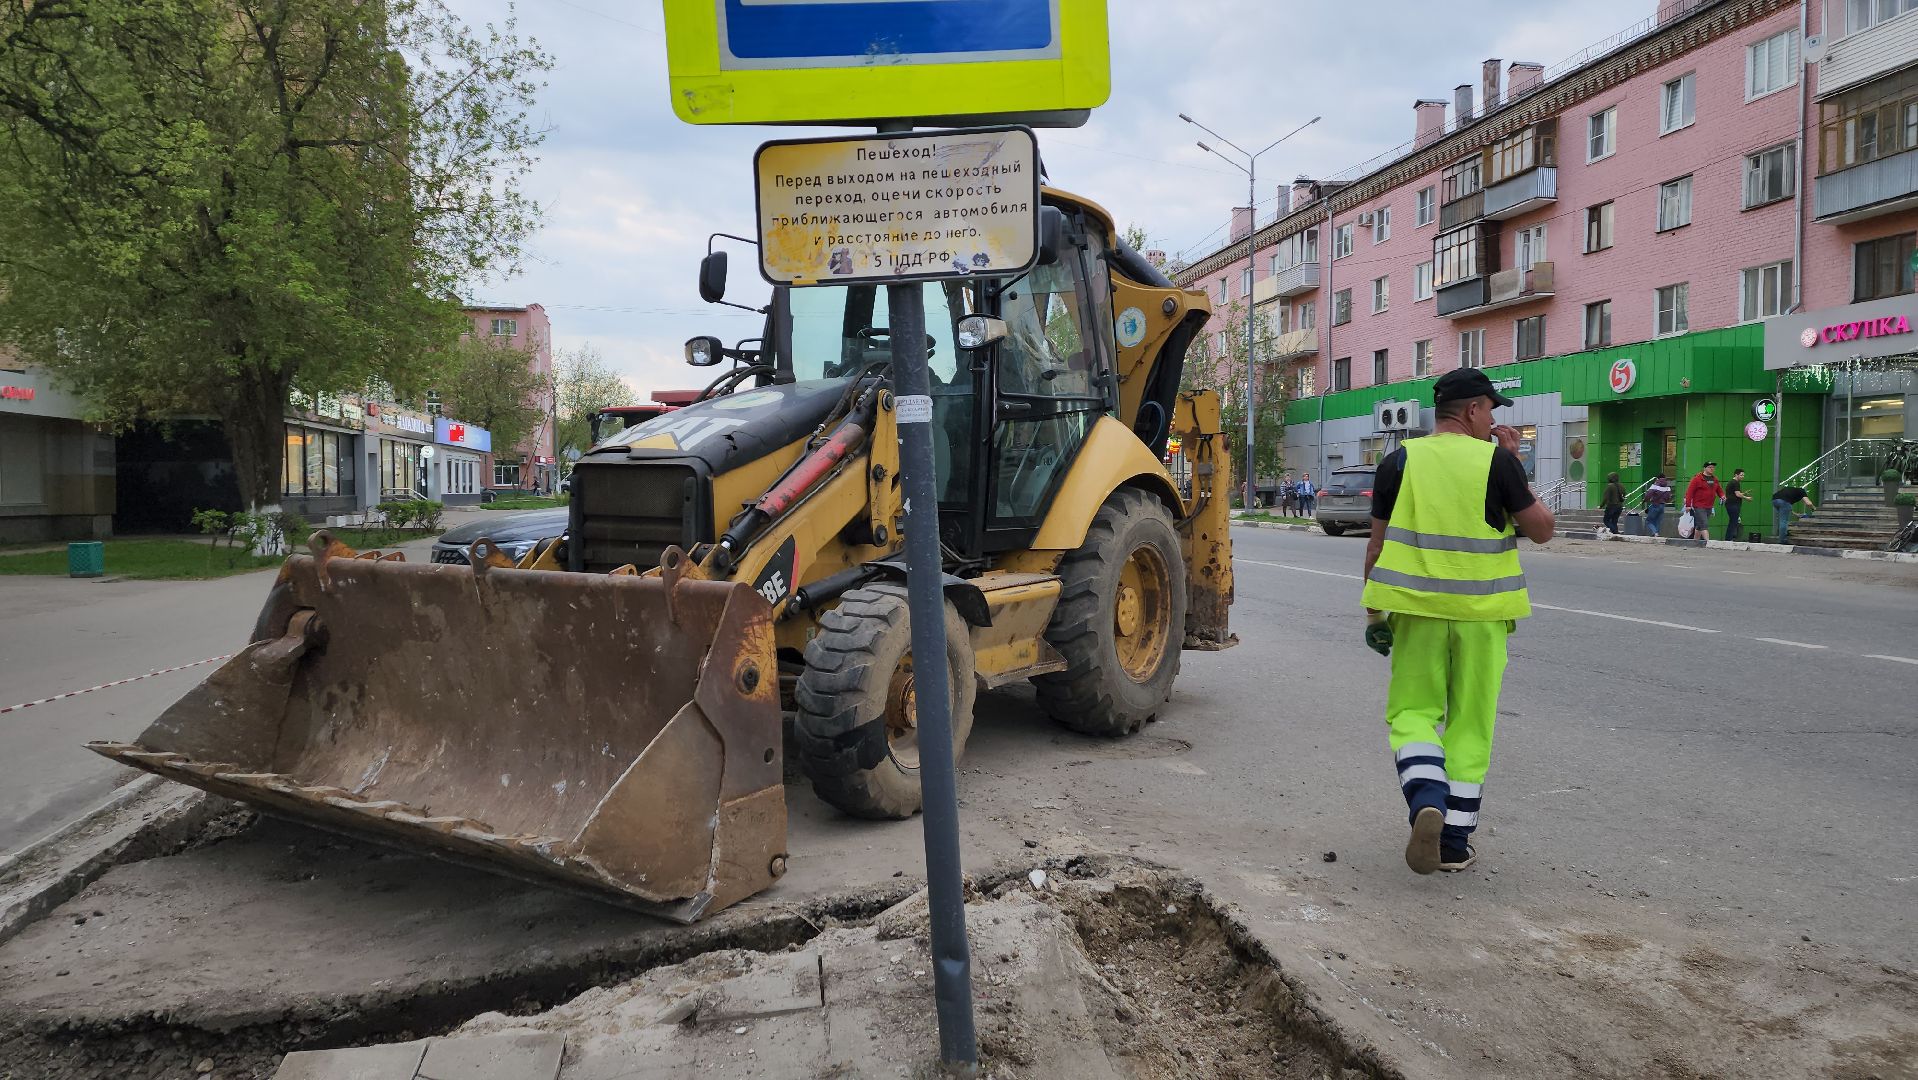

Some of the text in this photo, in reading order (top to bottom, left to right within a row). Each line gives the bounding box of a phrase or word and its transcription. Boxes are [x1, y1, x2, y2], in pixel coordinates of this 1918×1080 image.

[857, 144, 937, 161] Пешеход!
[775, 160, 1022, 189] Перед выходом на пешеходный
[795, 191, 867, 206] переход,
[926, 184, 1002, 202] скорость
[771, 202, 1028, 230] приближающегося автомобиля
[827, 230, 919, 248] расстояние
[1821, 314, 1913, 344] СКУПКА
[757, 570, 787, 605] 8E
